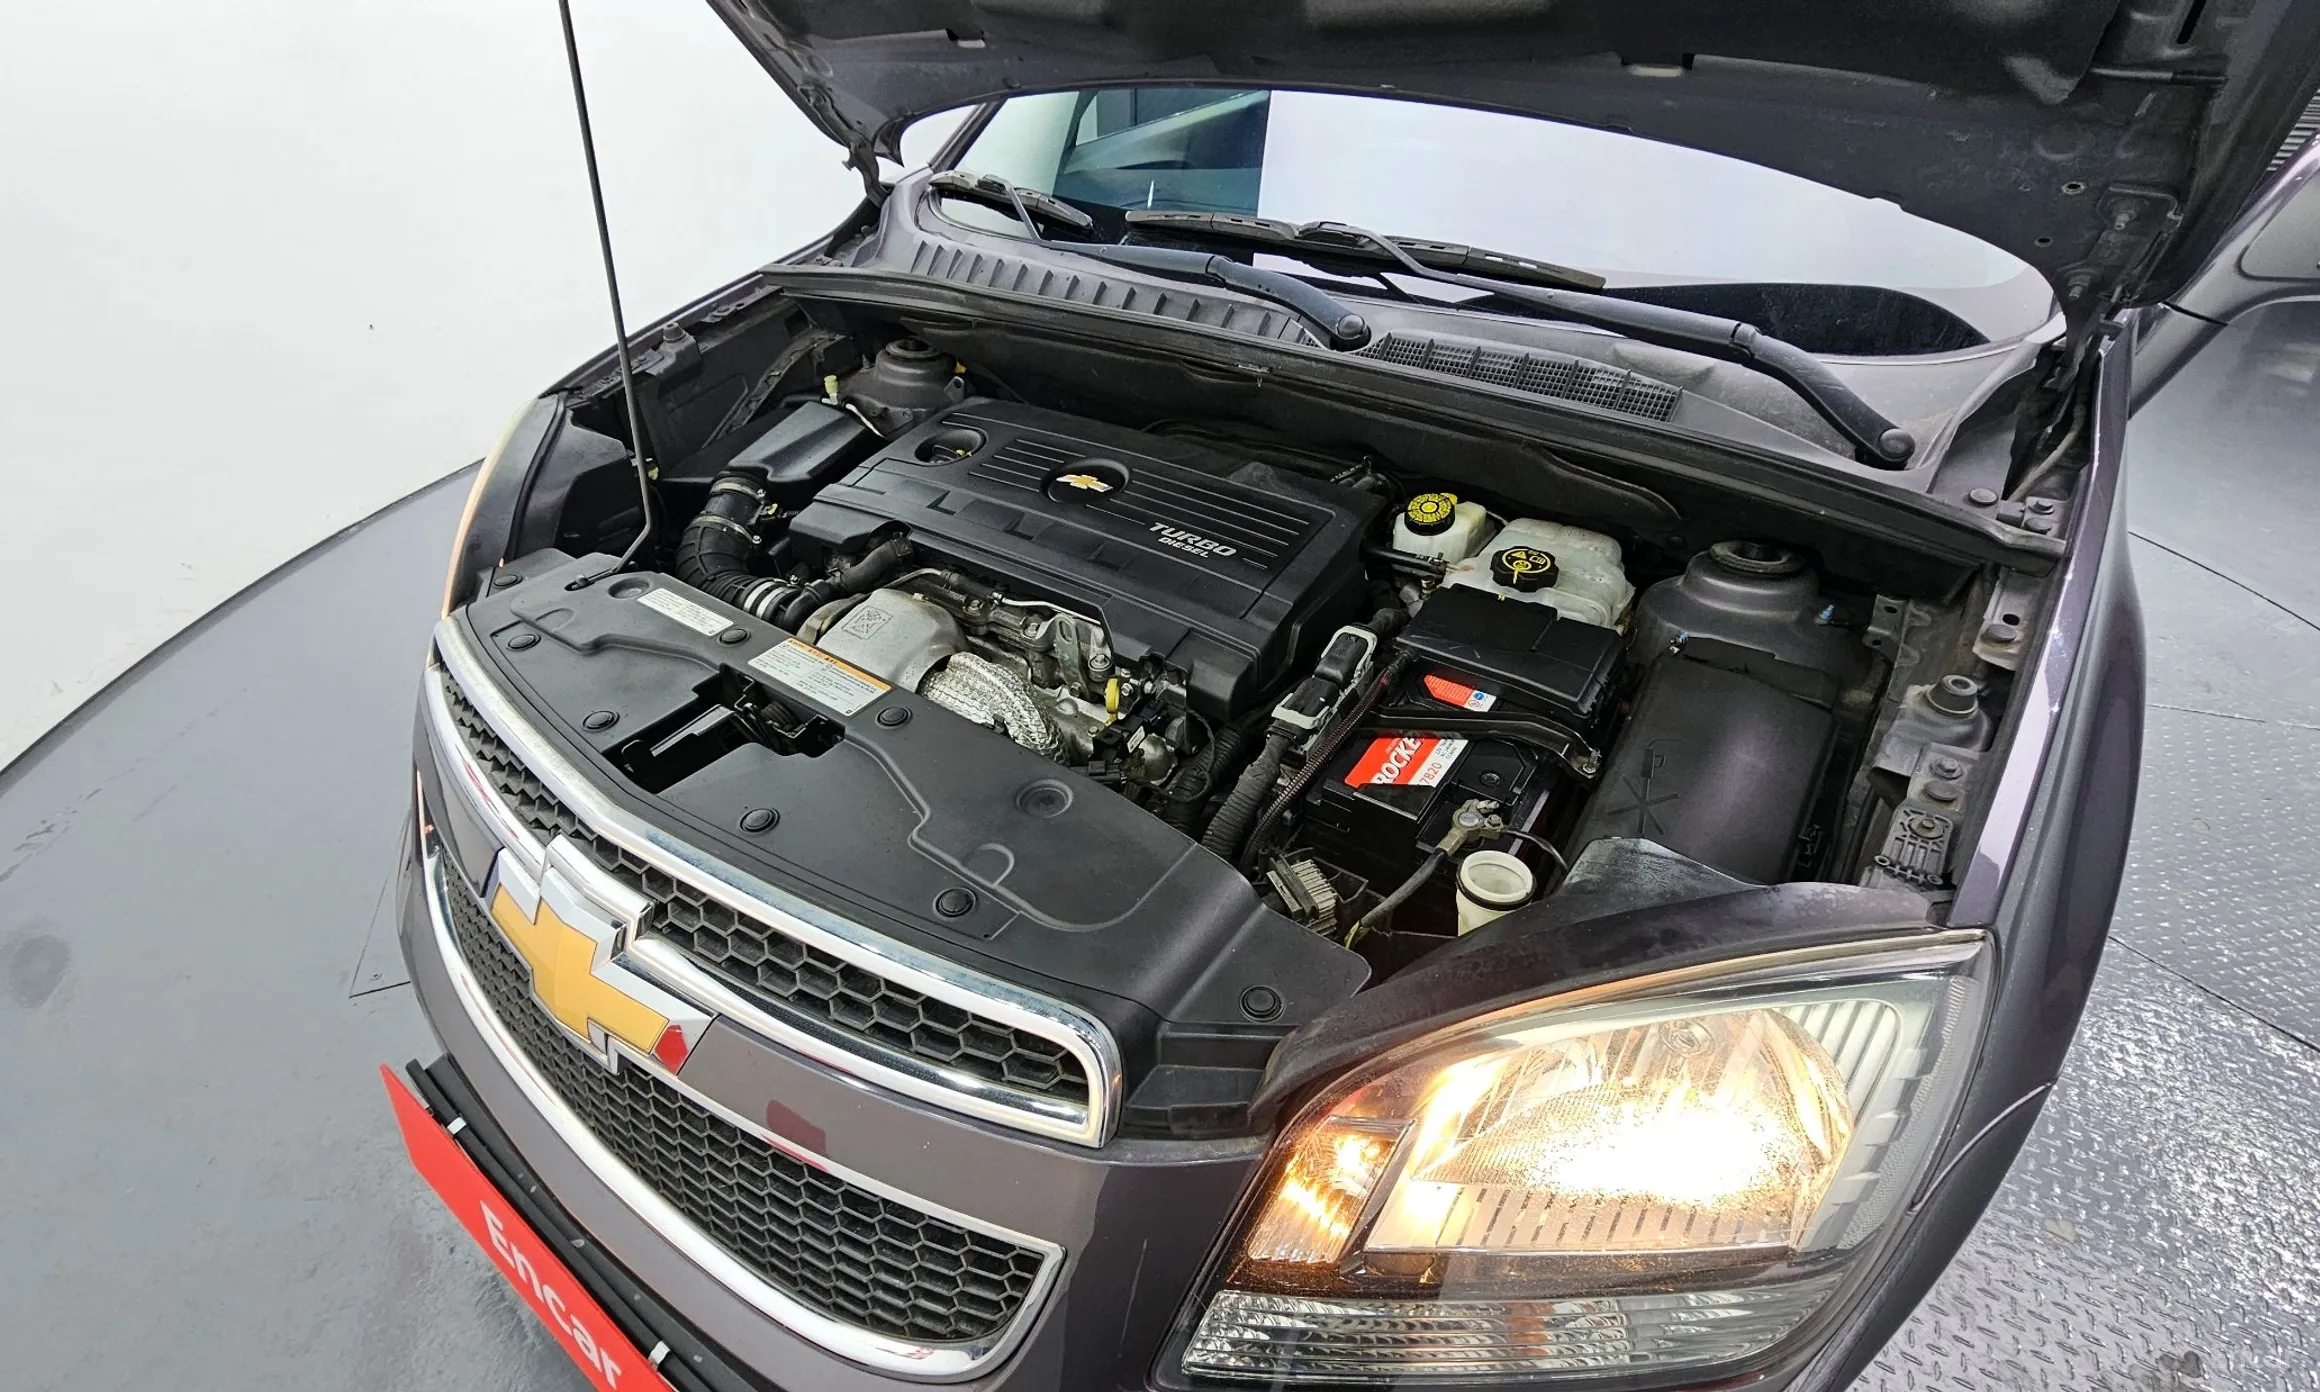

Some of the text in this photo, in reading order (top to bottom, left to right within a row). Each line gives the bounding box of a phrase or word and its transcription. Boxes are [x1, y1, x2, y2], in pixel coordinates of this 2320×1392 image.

[1149, 521, 1237, 557] TURBO
[1158, 536, 1209, 558] DIESEL
[480, 1200, 622, 1390] Encar
